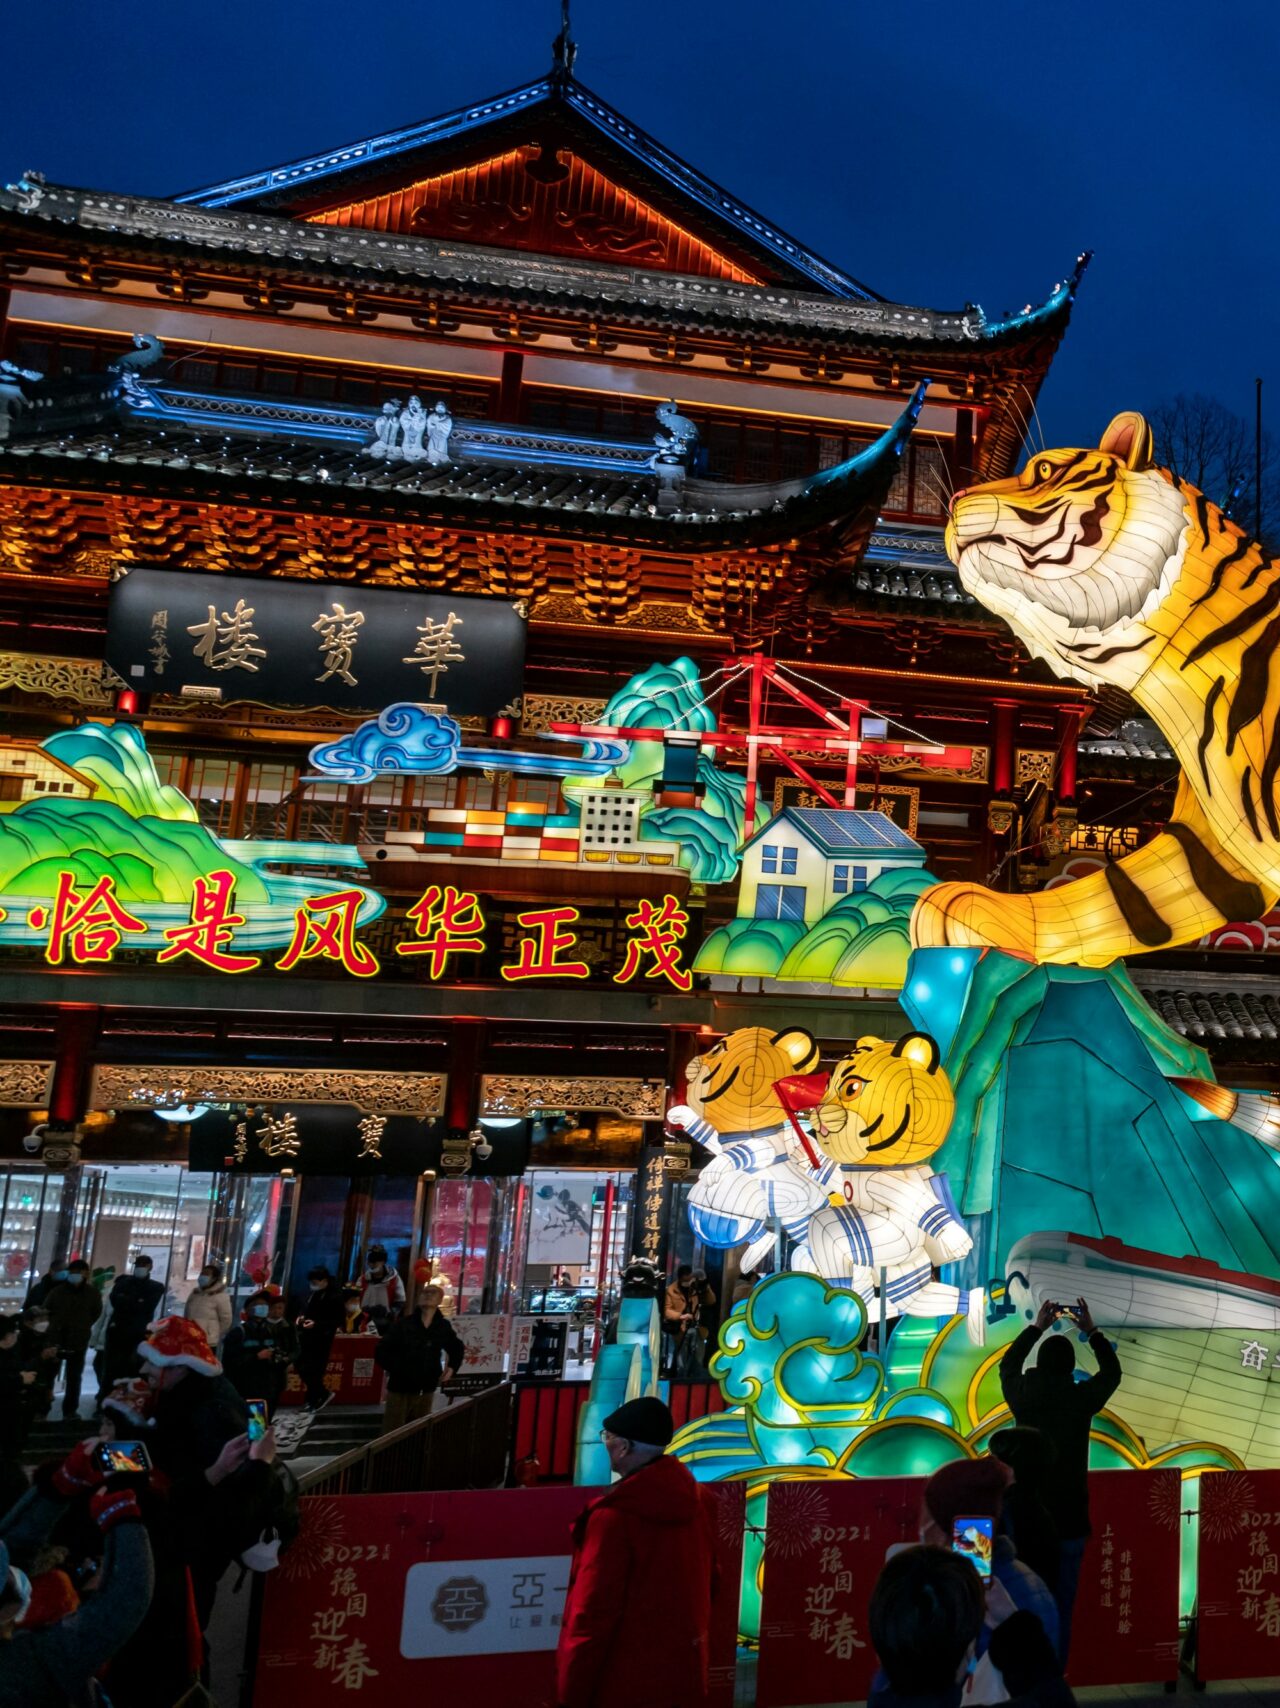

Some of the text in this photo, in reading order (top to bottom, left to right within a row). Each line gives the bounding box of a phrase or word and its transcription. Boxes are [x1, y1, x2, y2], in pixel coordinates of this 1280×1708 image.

[27, 869, 694, 991] 恰是风华正茂
[811, 1525, 861, 1543] 2022
[322, 1544, 379, 1564] 2022
